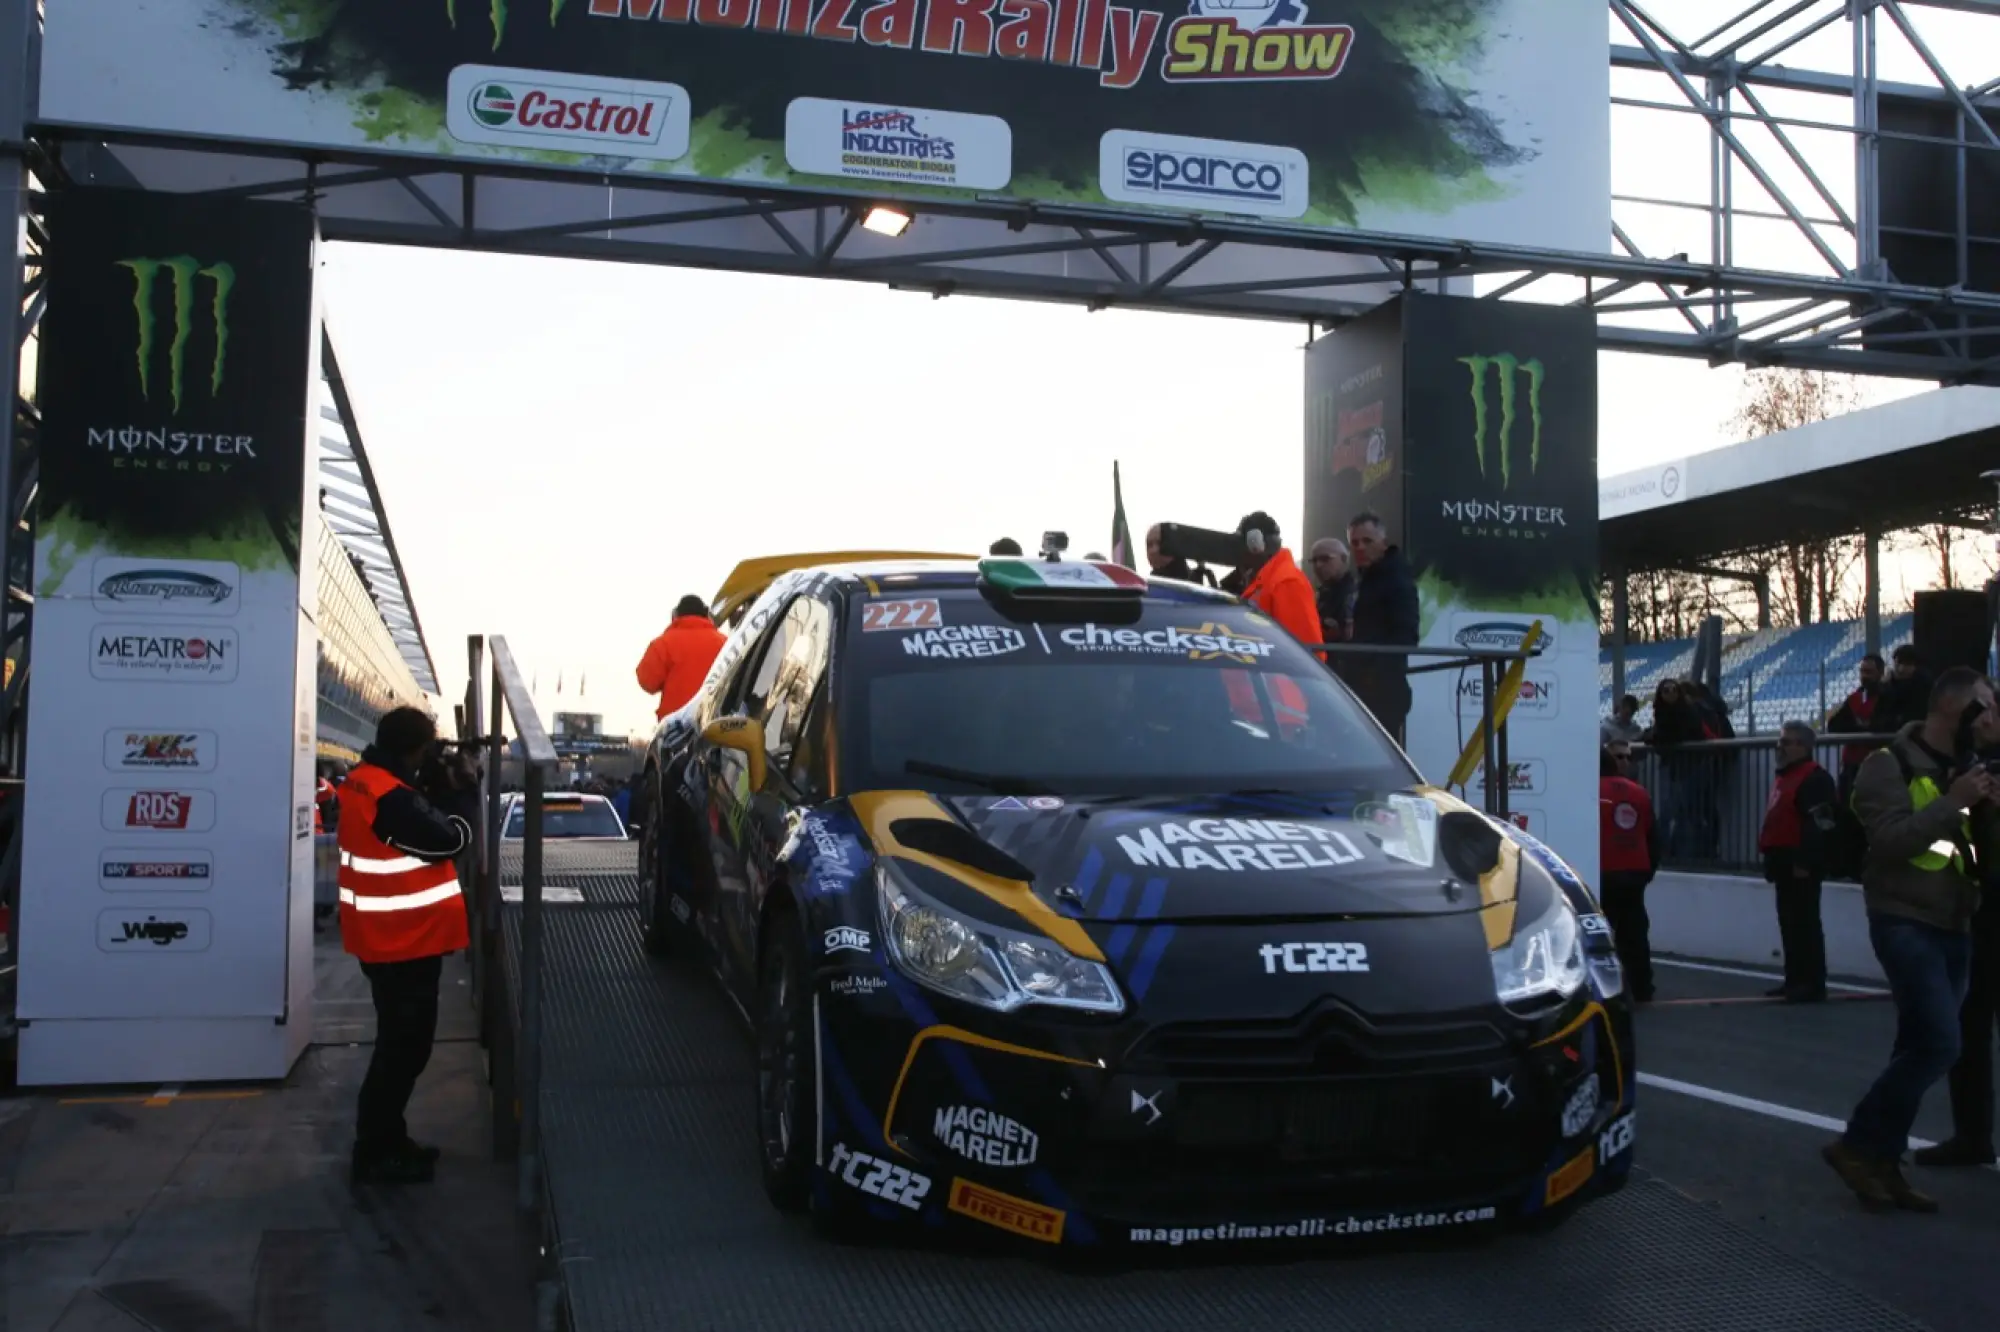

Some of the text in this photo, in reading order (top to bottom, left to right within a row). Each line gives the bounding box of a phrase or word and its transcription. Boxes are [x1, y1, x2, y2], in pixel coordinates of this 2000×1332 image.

[588, 0, 1163, 89] onzaRally
[1170, 25, 1345, 73] Show
[518, 91, 654, 137] Castrol
[842, 133, 955, 161] INDUSTRIES
[1127, 151, 1282, 191] sparco
[88, 425, 257, 458] MONSTER
[113, 457, 232, 472] ENERGY
[1441, 498, 1567, 527] MONSTER
[1461, 525, 1550, 539] ENERGY
[863, 602, 937, 630] 222
[98, 637, 224, 660] METATRON
[1061, 623, 1275, 656] checkstar
[135, 794, 179, 820] RDS
[1116, 818, 1362, 851] MAGNETI
[134, 864, 185, 876] SPORT
[188, 865, 206, 875] HD
[1116, 840, 1364, 870] MARELLI
[825, 931, 870, 947] OMP
[933, 1105, 1038, 1147] MAGNETI
[935, 1127, 1038, 1167] MARELLI
[958, 1185, 1057, 1236] PIRELLI
